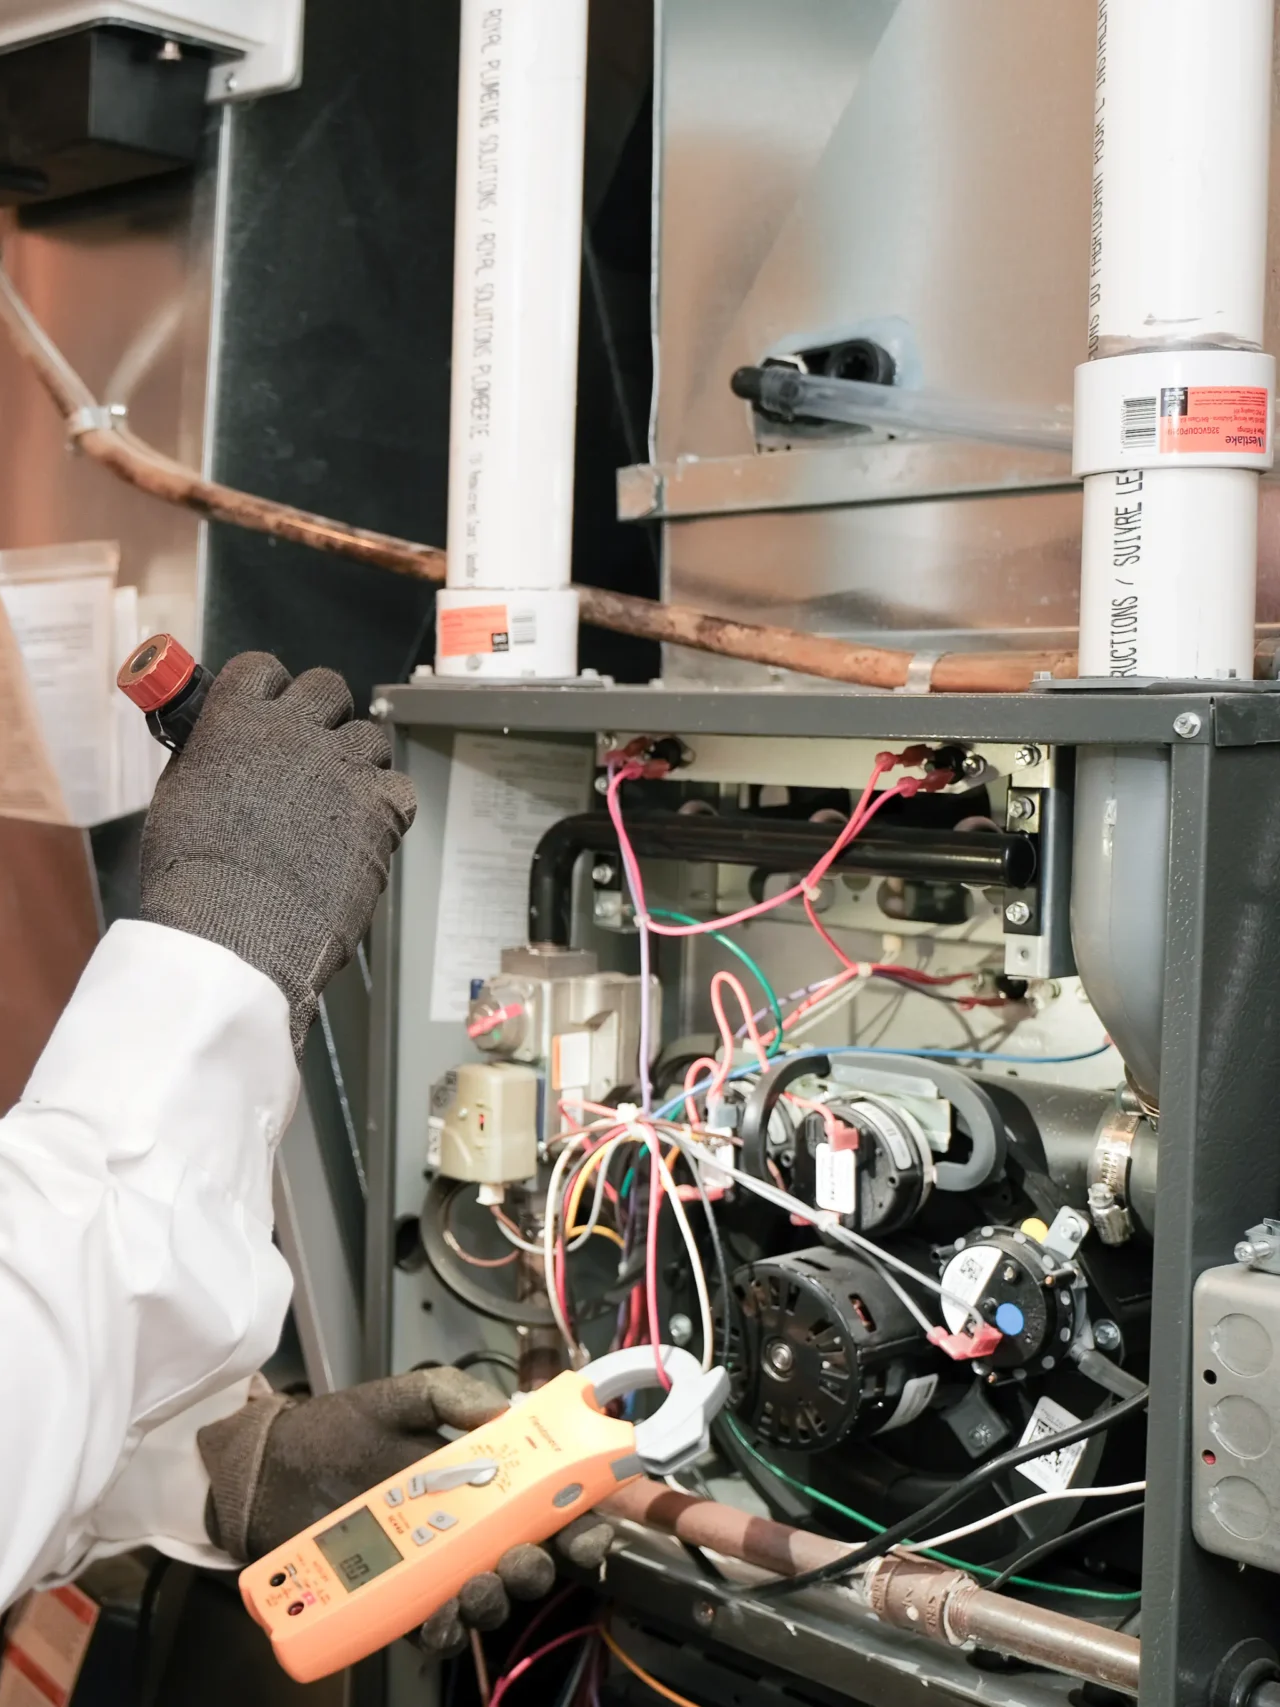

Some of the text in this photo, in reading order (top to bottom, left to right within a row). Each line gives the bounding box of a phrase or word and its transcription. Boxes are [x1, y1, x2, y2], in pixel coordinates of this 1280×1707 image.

[481, 8, 503, 54] ROYAL
[1093, 118, 1105, 165] POUR
[477, 134, 500, 211] SOLUTIONS
[475, 232, 496, 277] ROYAL
[473, 282, 495, 358] SOLUTIONS
[1225, 435, 1265, 447] Westlake
[1113, 501, 1142, 567] SUIVRE
